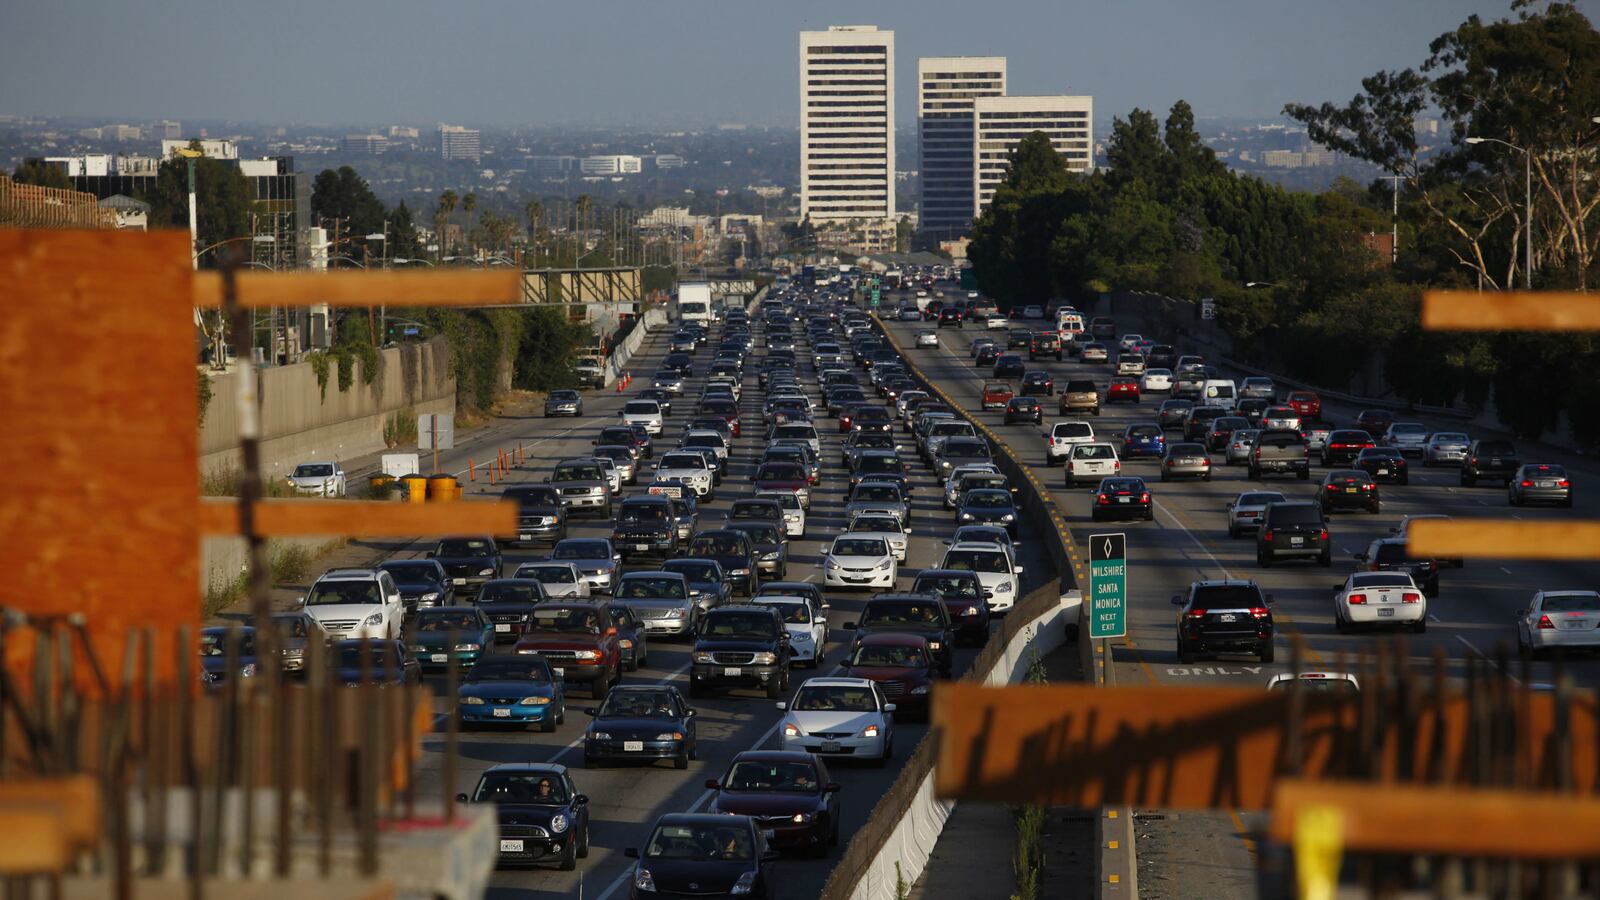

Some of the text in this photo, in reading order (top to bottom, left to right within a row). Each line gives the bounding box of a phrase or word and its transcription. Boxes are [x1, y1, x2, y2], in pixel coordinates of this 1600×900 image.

[1092, 565, 1124, 577] WILSHIRE
[1098, 583, 1118, 594] SANTA
[1095, 599, 1121, 609] MONICA
[1100, 613, 1117, 621] NEXT
[1101, 623, 1115, 631] EXIT
[1166, 666, 1262, 676] ONLY
